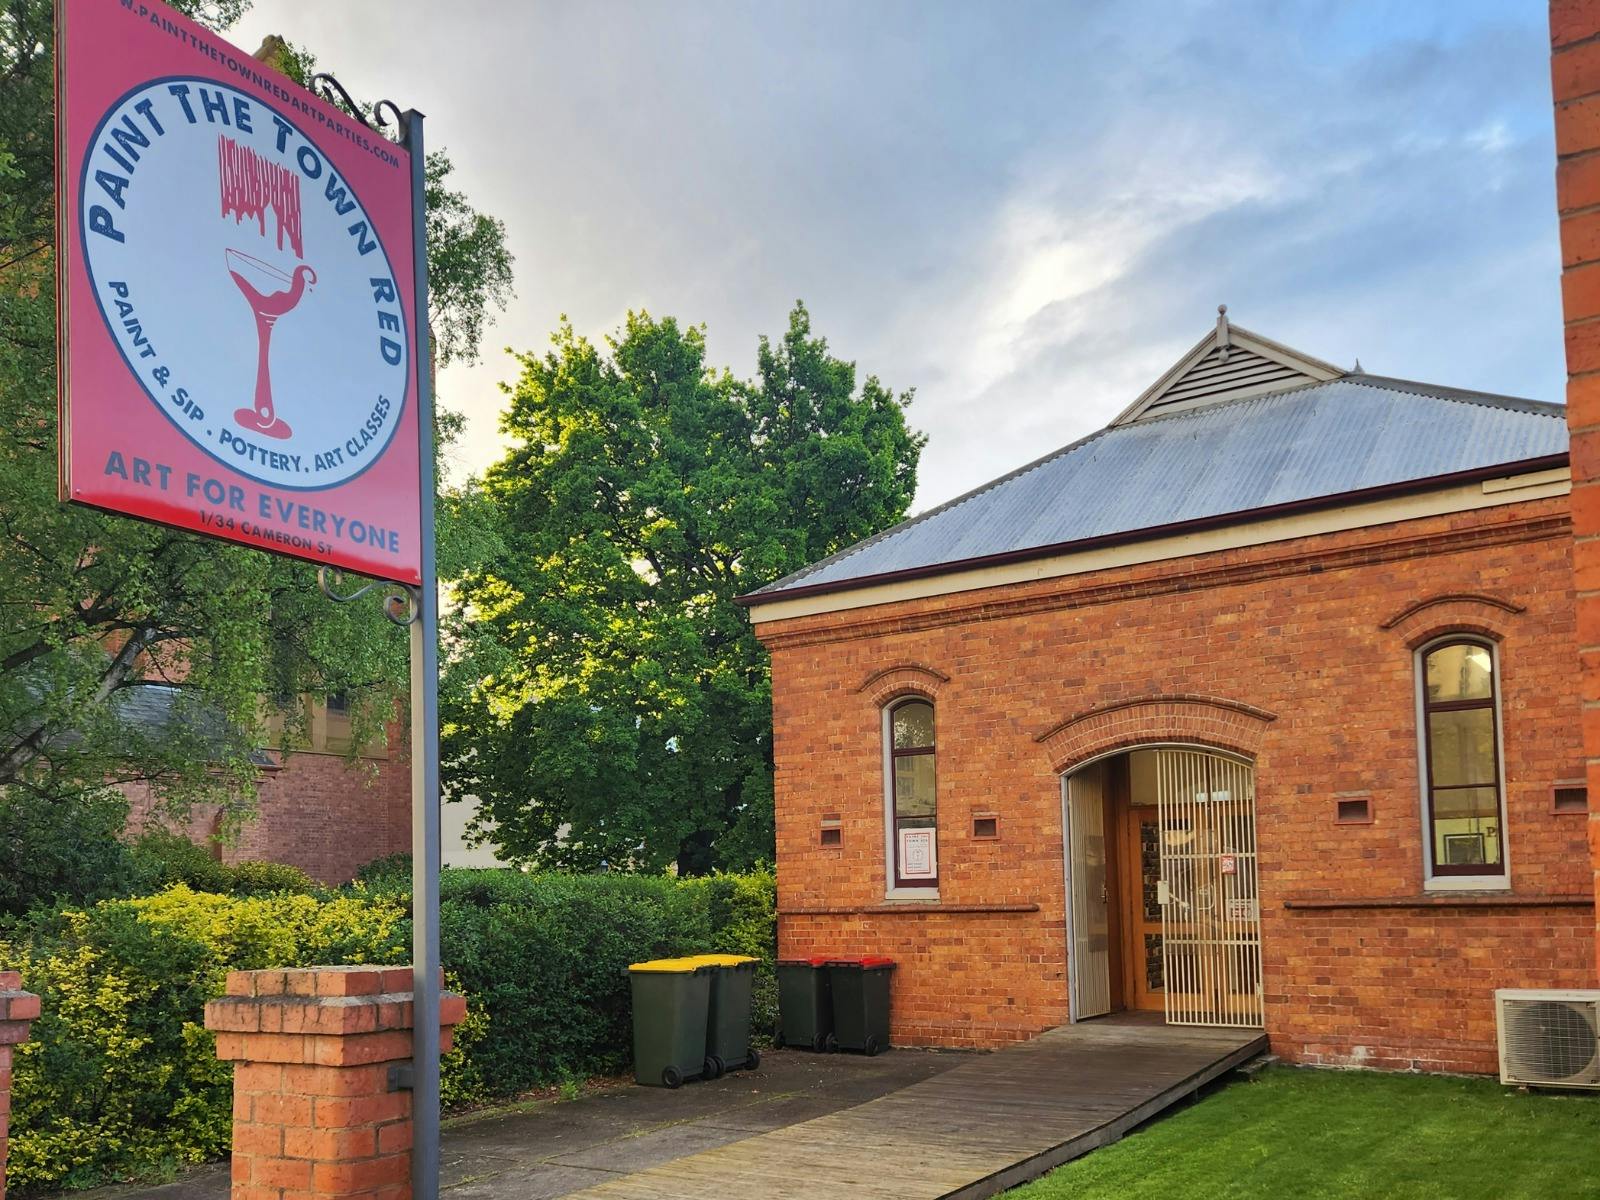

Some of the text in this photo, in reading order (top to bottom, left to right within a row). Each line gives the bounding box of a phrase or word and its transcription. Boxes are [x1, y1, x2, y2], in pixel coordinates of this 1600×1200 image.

[89, 84, 402, 367] PAINT THE TOWN RED
[108, 280, 156, 359] PAINT
[151, 365, 171, 389] &
[314, 450, 344, 472] ART
[345, 394, 391, 456] CLASSES
[103, 451, 400, 554] ART FOR EVERYONE
[199, 509, 333, 556] 1/34 CAMERON ST
